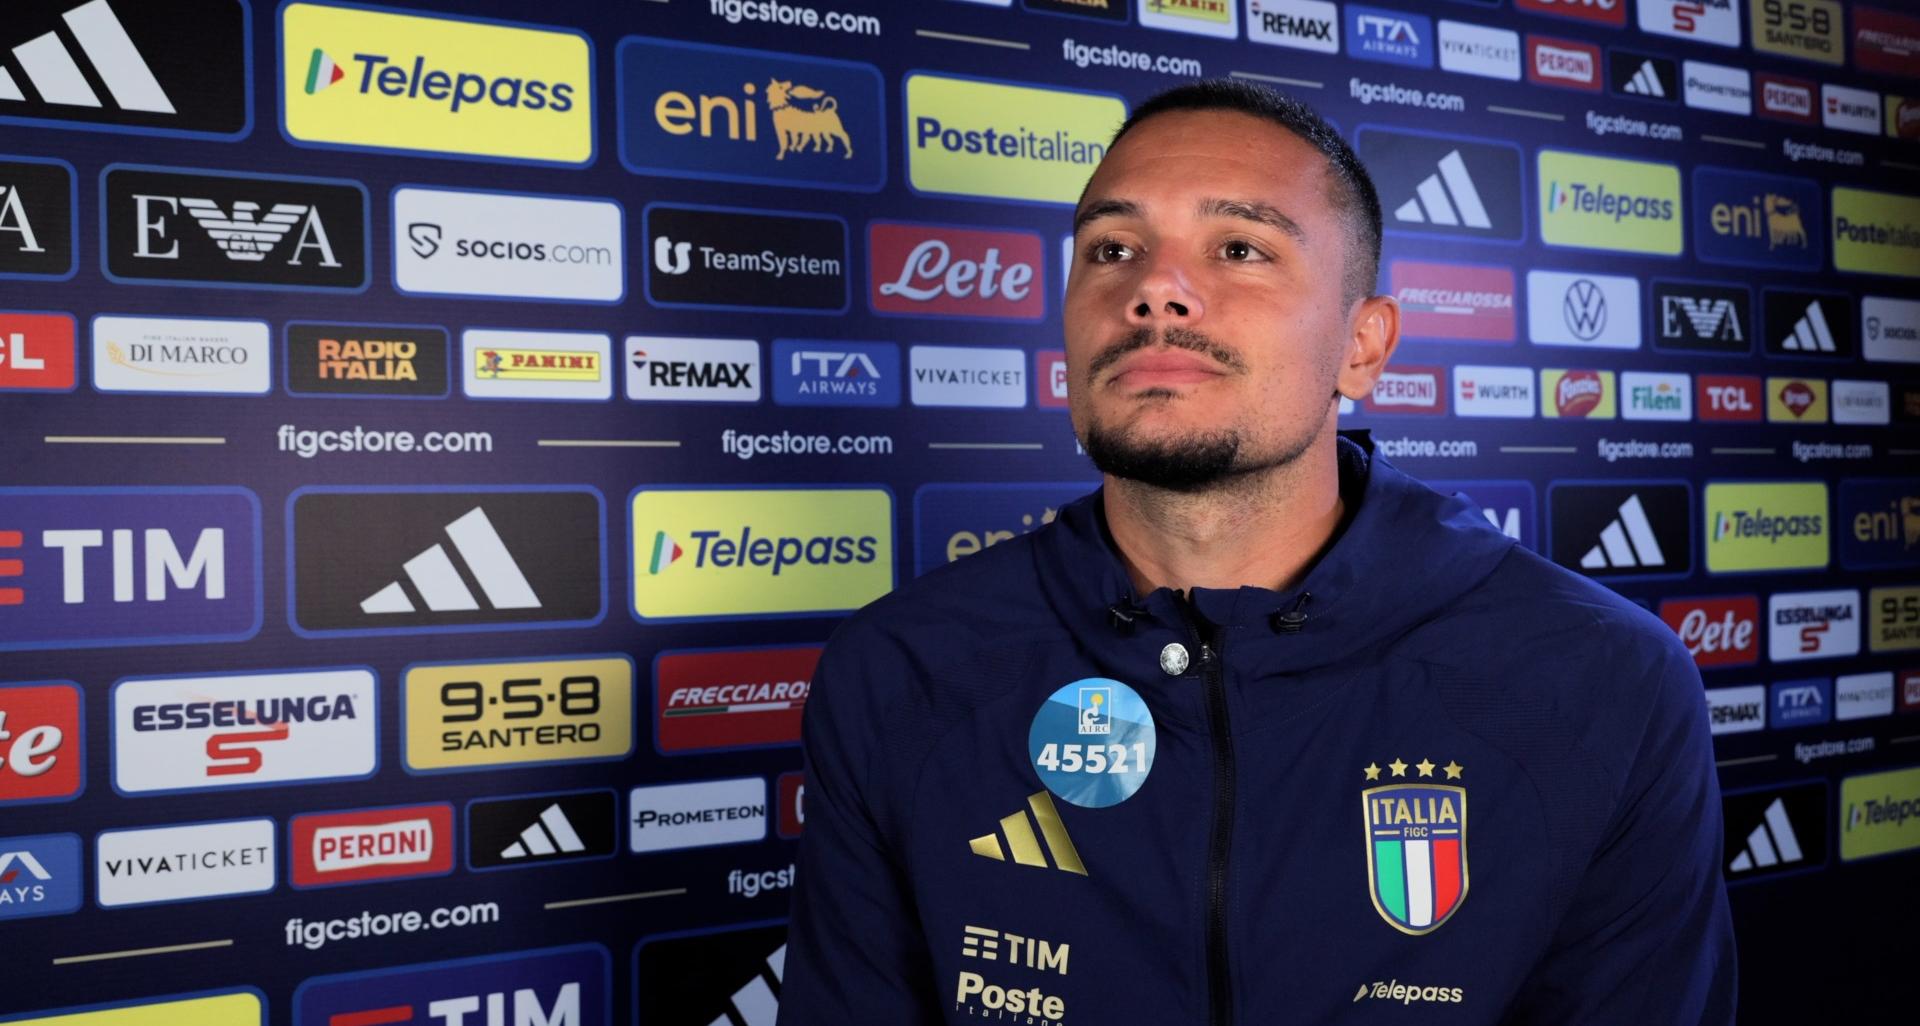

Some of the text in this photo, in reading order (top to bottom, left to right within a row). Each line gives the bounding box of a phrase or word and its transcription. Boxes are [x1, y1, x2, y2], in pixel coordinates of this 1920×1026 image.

[1262, 12, 1332, 42] REMAX
[1357, 14, 1420, 44] ITA
[1062, 38, 1202, 77] figcstore.com
[1363, 40, 1418, 59] AIRWAYS
[1443, 39, 1517, 63] VIVATICKET
[1538, 51, 1590, 75] PERONI
[353, 53, 574, 113] Telepass
[1349, 77, 1465, 112] figcstore.com
[654, 82, 757, 142] eni
[1585, 110, 1684, 142] figcstore.com
[1570, 183, 1674, 222] Telepass
[1711, 196, 1762, 238] eni
[699, 246, 840, 278] TeamSystem
[879, 240, 1033, 301] Lete
[1400, 286, 1513, 309] FRECCIAROSSA
[130, 343, 249, 366] DI MARCO
[319, 339, 417, 361] RADIO
[511, 350, 595, 369] PANINI
[791, 351, 881, 379] ITA
[319, 360, 417, 381] ITALIA
[649, 361, 753, 388] REMAX
[915, 368, 1021, 386] VIVATICKET
[798, 380, 877, 396] AIRWAYS
[1376, 380, 1434, 399] PERONI
[1706, 386, 1752, 411] TCL
[277, 424, 493, 458] figcstore.com
[721, 429, 893, 460] figcstore.com
[1598, 438, 1693, 462] figcstore.com
[1733, 508, 1823, 543] Telepass
[42, 527, 226, 604] TIM
[690, 526, 877, 576] Telepass
[1678, 608, 1754, 656] Lete
[133, 694, 357, 733] ESSELUNGA
[440, 722, 601, 752] SANTERO
[1080, 724, 1109, 734] AIRC
[1036, 742, 1147, 775] 45521
[632, 804, 766, 829] PROMETEON
[1371, 797, 1458, 825] ITALIA
[319, 829, 427, 861] PERONI
[1403, 826, 1429, 838] FIGC
[105, 845, 269, 878] VIVATICKET
[284, 902, 500, 950] figcstore.com
[1003, 932, 1070, 975] TIM
[956, 970, 1066, 1021] Poste
[1369, 978, 1464, 1006] Telepass
